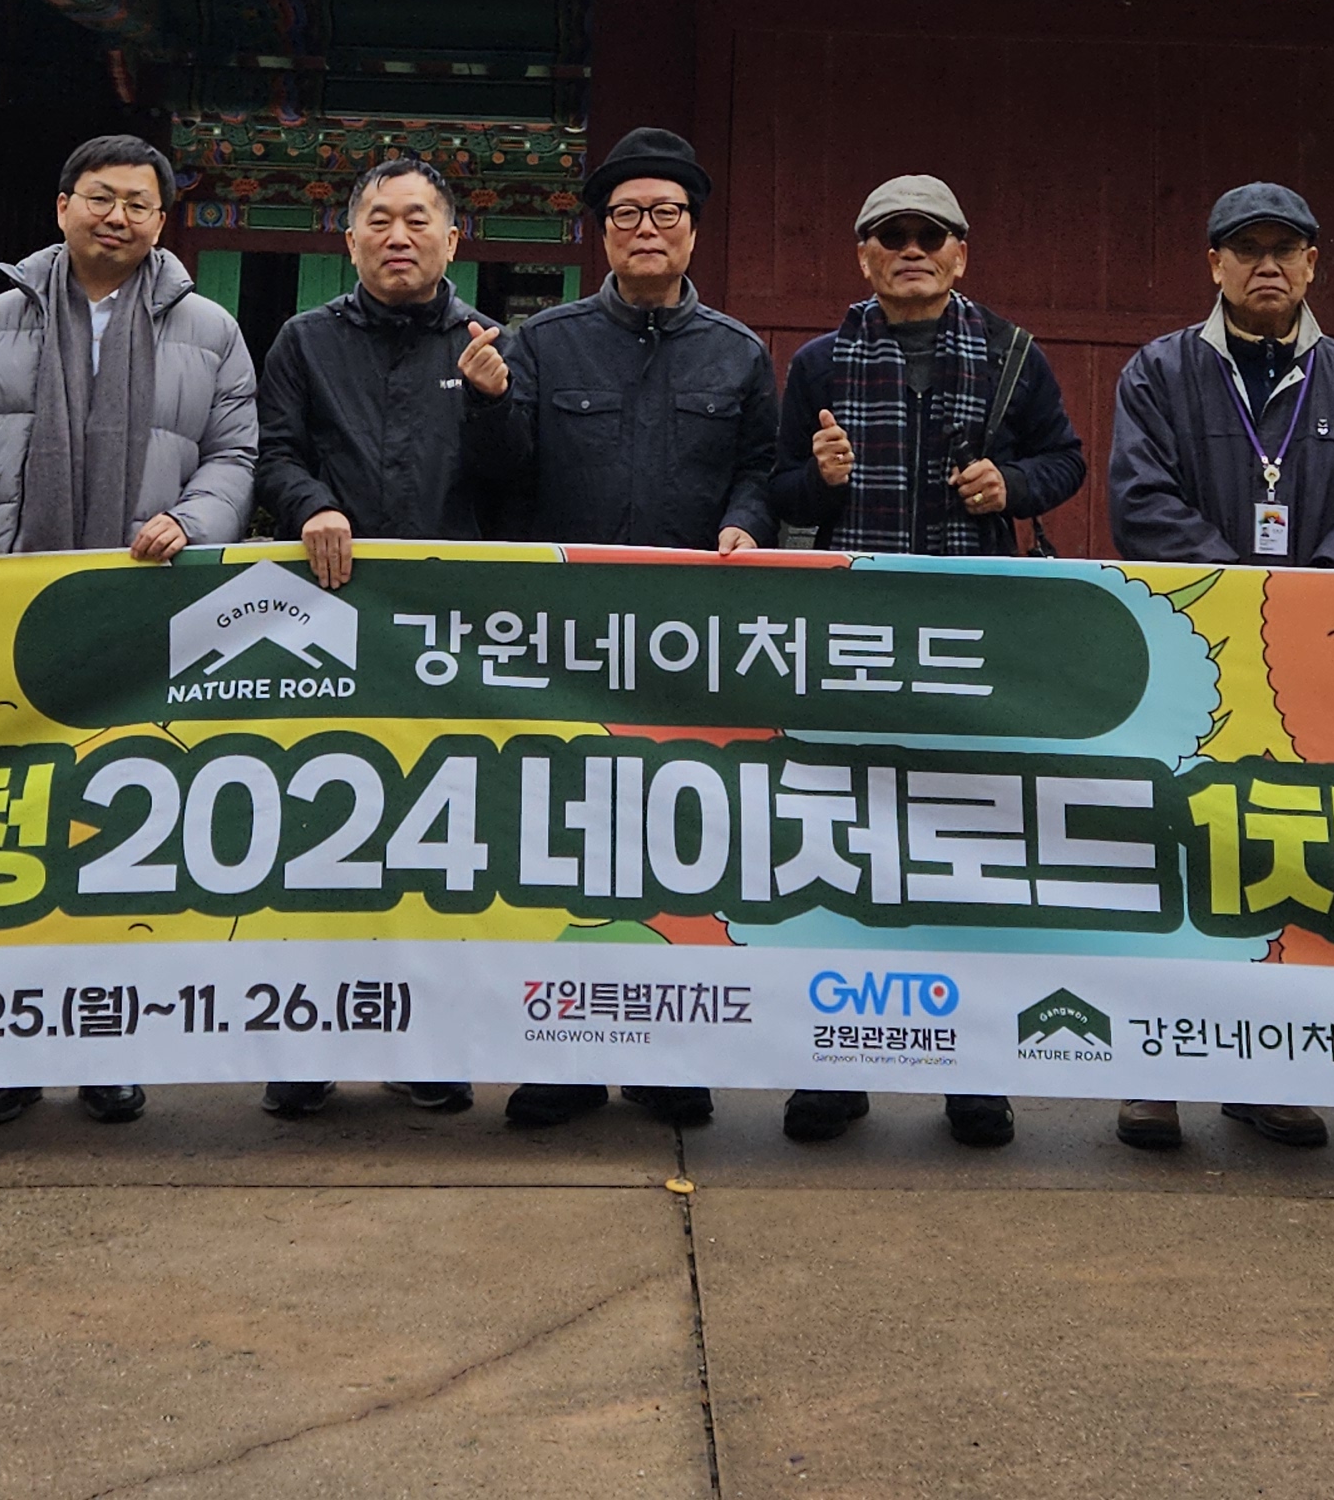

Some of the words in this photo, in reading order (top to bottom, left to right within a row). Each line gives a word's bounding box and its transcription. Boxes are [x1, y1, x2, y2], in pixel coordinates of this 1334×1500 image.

[216, 599, 311, 628] Gangwon
[393, 609, 995, 696] 강원네이처로드
[167, 678, 272, 704] NATURE
[279, 677, 357, 699] ROAD
[77, 753, 489, 896] 2024
[519, 757, 1163, 914] 네이처로드
[244, 979, 411, 1033] 26.(화)
[523, 980, 752, 1024] 강원특별자치도
[808, 970, 961, 1017] GWTO
[1039, 1006, 1090, 1024] Gangwon
[524, 1029, 605, 1044] GANGWON
[609, 1030, 652, 1044] STATE
[813, 1025, 958, 1052] 강원관광재단
[1017, 1048, 1071, 1061] NATURE
[1074, 1050, 1113, 1062] ROAD
